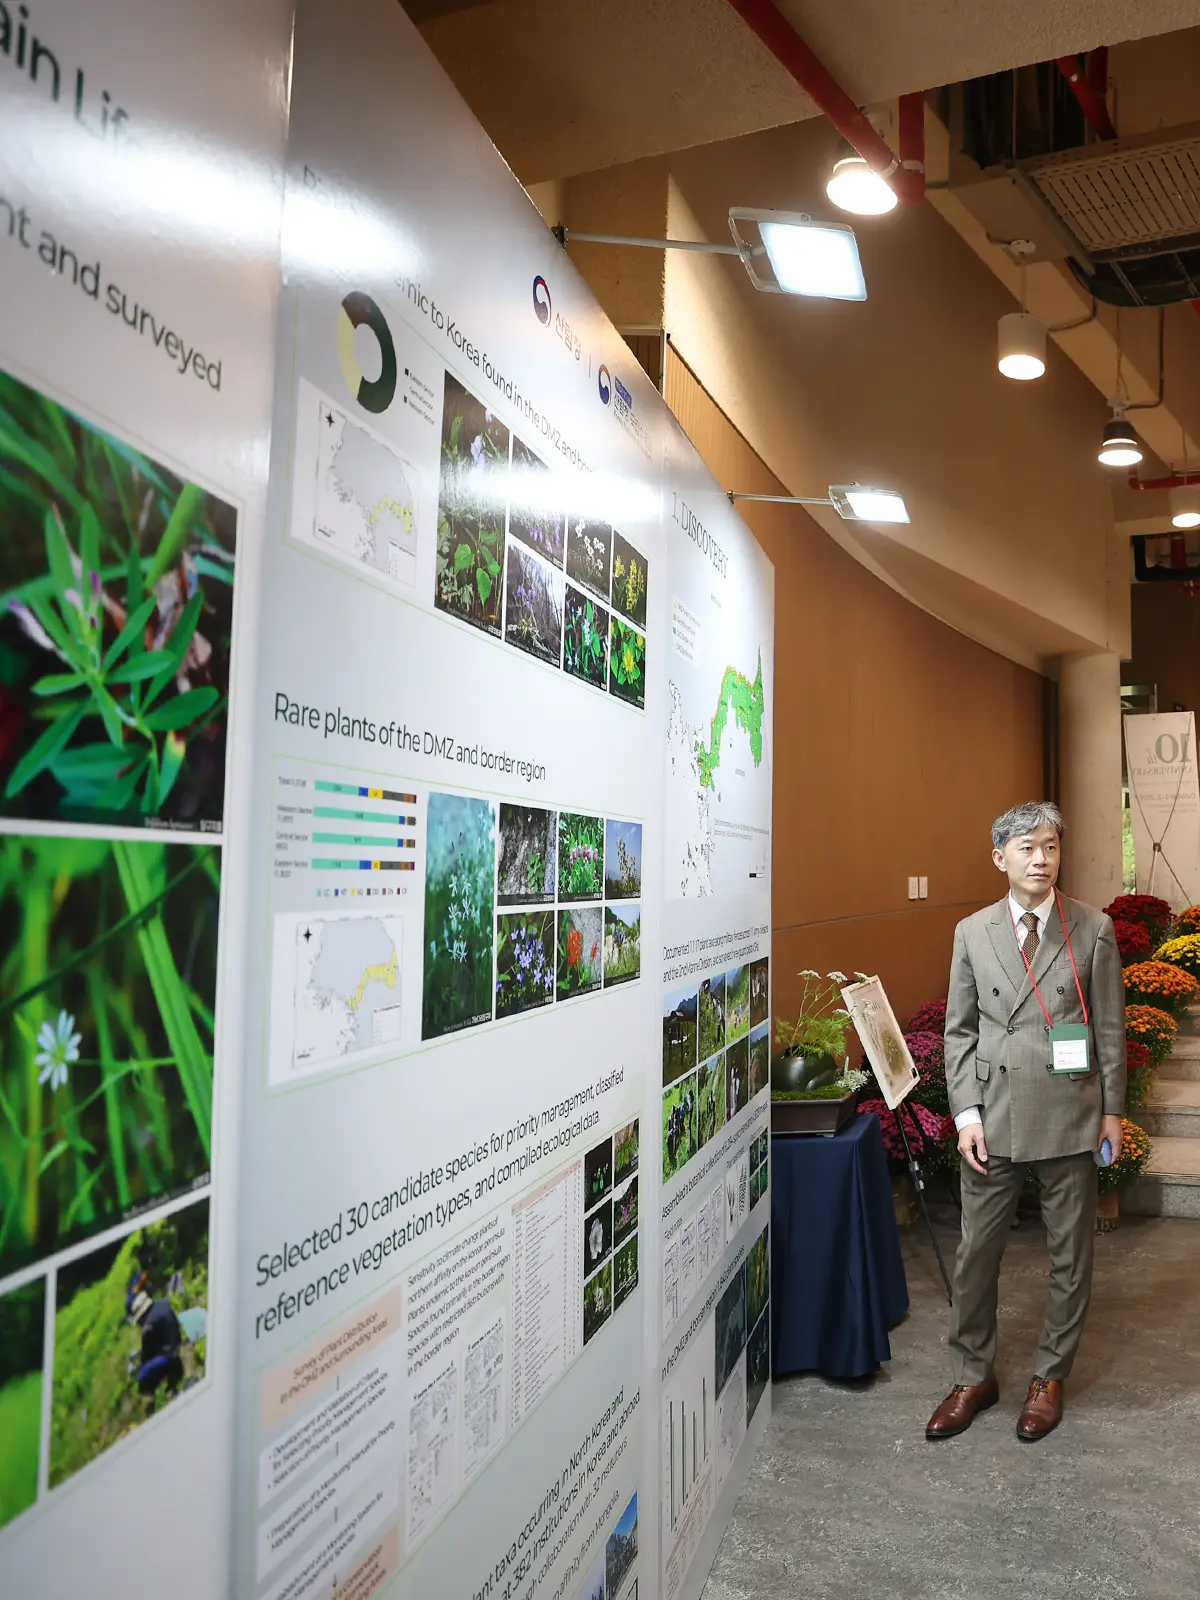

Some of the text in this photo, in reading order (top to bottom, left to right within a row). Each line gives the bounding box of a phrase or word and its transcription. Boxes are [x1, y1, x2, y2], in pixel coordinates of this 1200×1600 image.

[38, 231, 99, 301] and
[106, 282, 222, 392] surveyed
[555, 312, 582, 361] 산림청
[431, 301, 443, 330] to
[446, 315, 480, 368] Korea
[482, 353, 513, 399] found
[514, 386, 522, 409] in
[523, 399, 540, 425] the
[541, 415, 561, 450] DMZ
[562, 440, 577, 466] and
[681, 500, 729, 579] DISCOVERY
[274, 692, 546, 783] Rare plants of the DMZ and border region
[662, 941, 689, 961] Documented
[662, 967, 671, 982] and
[256, 1066, 624, 1287] Selected 30 candidate species for priority management, classified
[255, 1262, 350, 1340] reference
[352, 1211, 433, 1276] vegetation
[436, 1188, 472, 1229] types,
[474, 1167, 495, 1199] and
[497, 1140, 542, 1185] compiled
[543, 1116, 583, 1156] ecological
[408, 1262, 436, 1287] Sensitivity
[443, 1244, 461, 1263] climate
[461, 1231, 480, 1249] change
[407, 1318, 429, 1342] Species
[429, 1303, 446, 1324] found
[481, 1264, 497, 1282] border
[496, 1253, 511, 1270] region
[408, 1281, 433, 1305] northern
[433, 1267, 451, 1287] affinity
[408, 1302, 426, 1324] Plants
[426, 1286, 449, 1310] endemic
[407, 1335, 429, 1360] Species
[429, 1325, 442, 1341] with
[443, 1303, 467, 1331] restricted
[424, 1341, 443, 1363] border
[443, 1327, 460, 1348] region
[495, 1542, 517, 1583] taxa
[517, 1480, 560, 1551] occurring
[561, 1468, 569, 1487] in
[569, 1434, 591, 1476] North
[591, 1407, 611, 1444] Korea
[611, 1385, 624, 1414] and
[501, 1580, 512, 1600] at
[512, 1549, 532, 1591] 382
[533, 1482, 579, 1562] institutions
[578, 1472, 586, 1491] in
[586, 1441, 607, 1480] Korea
[607, 1418, 619, 1455] and
[619, 1386, 640, 1430] abroad
[538, 1511, 580, 1584] collaboration
[580, 1491, 592, 1518] with
[559, 1490, 620, 1596] affinity from Mongolia
